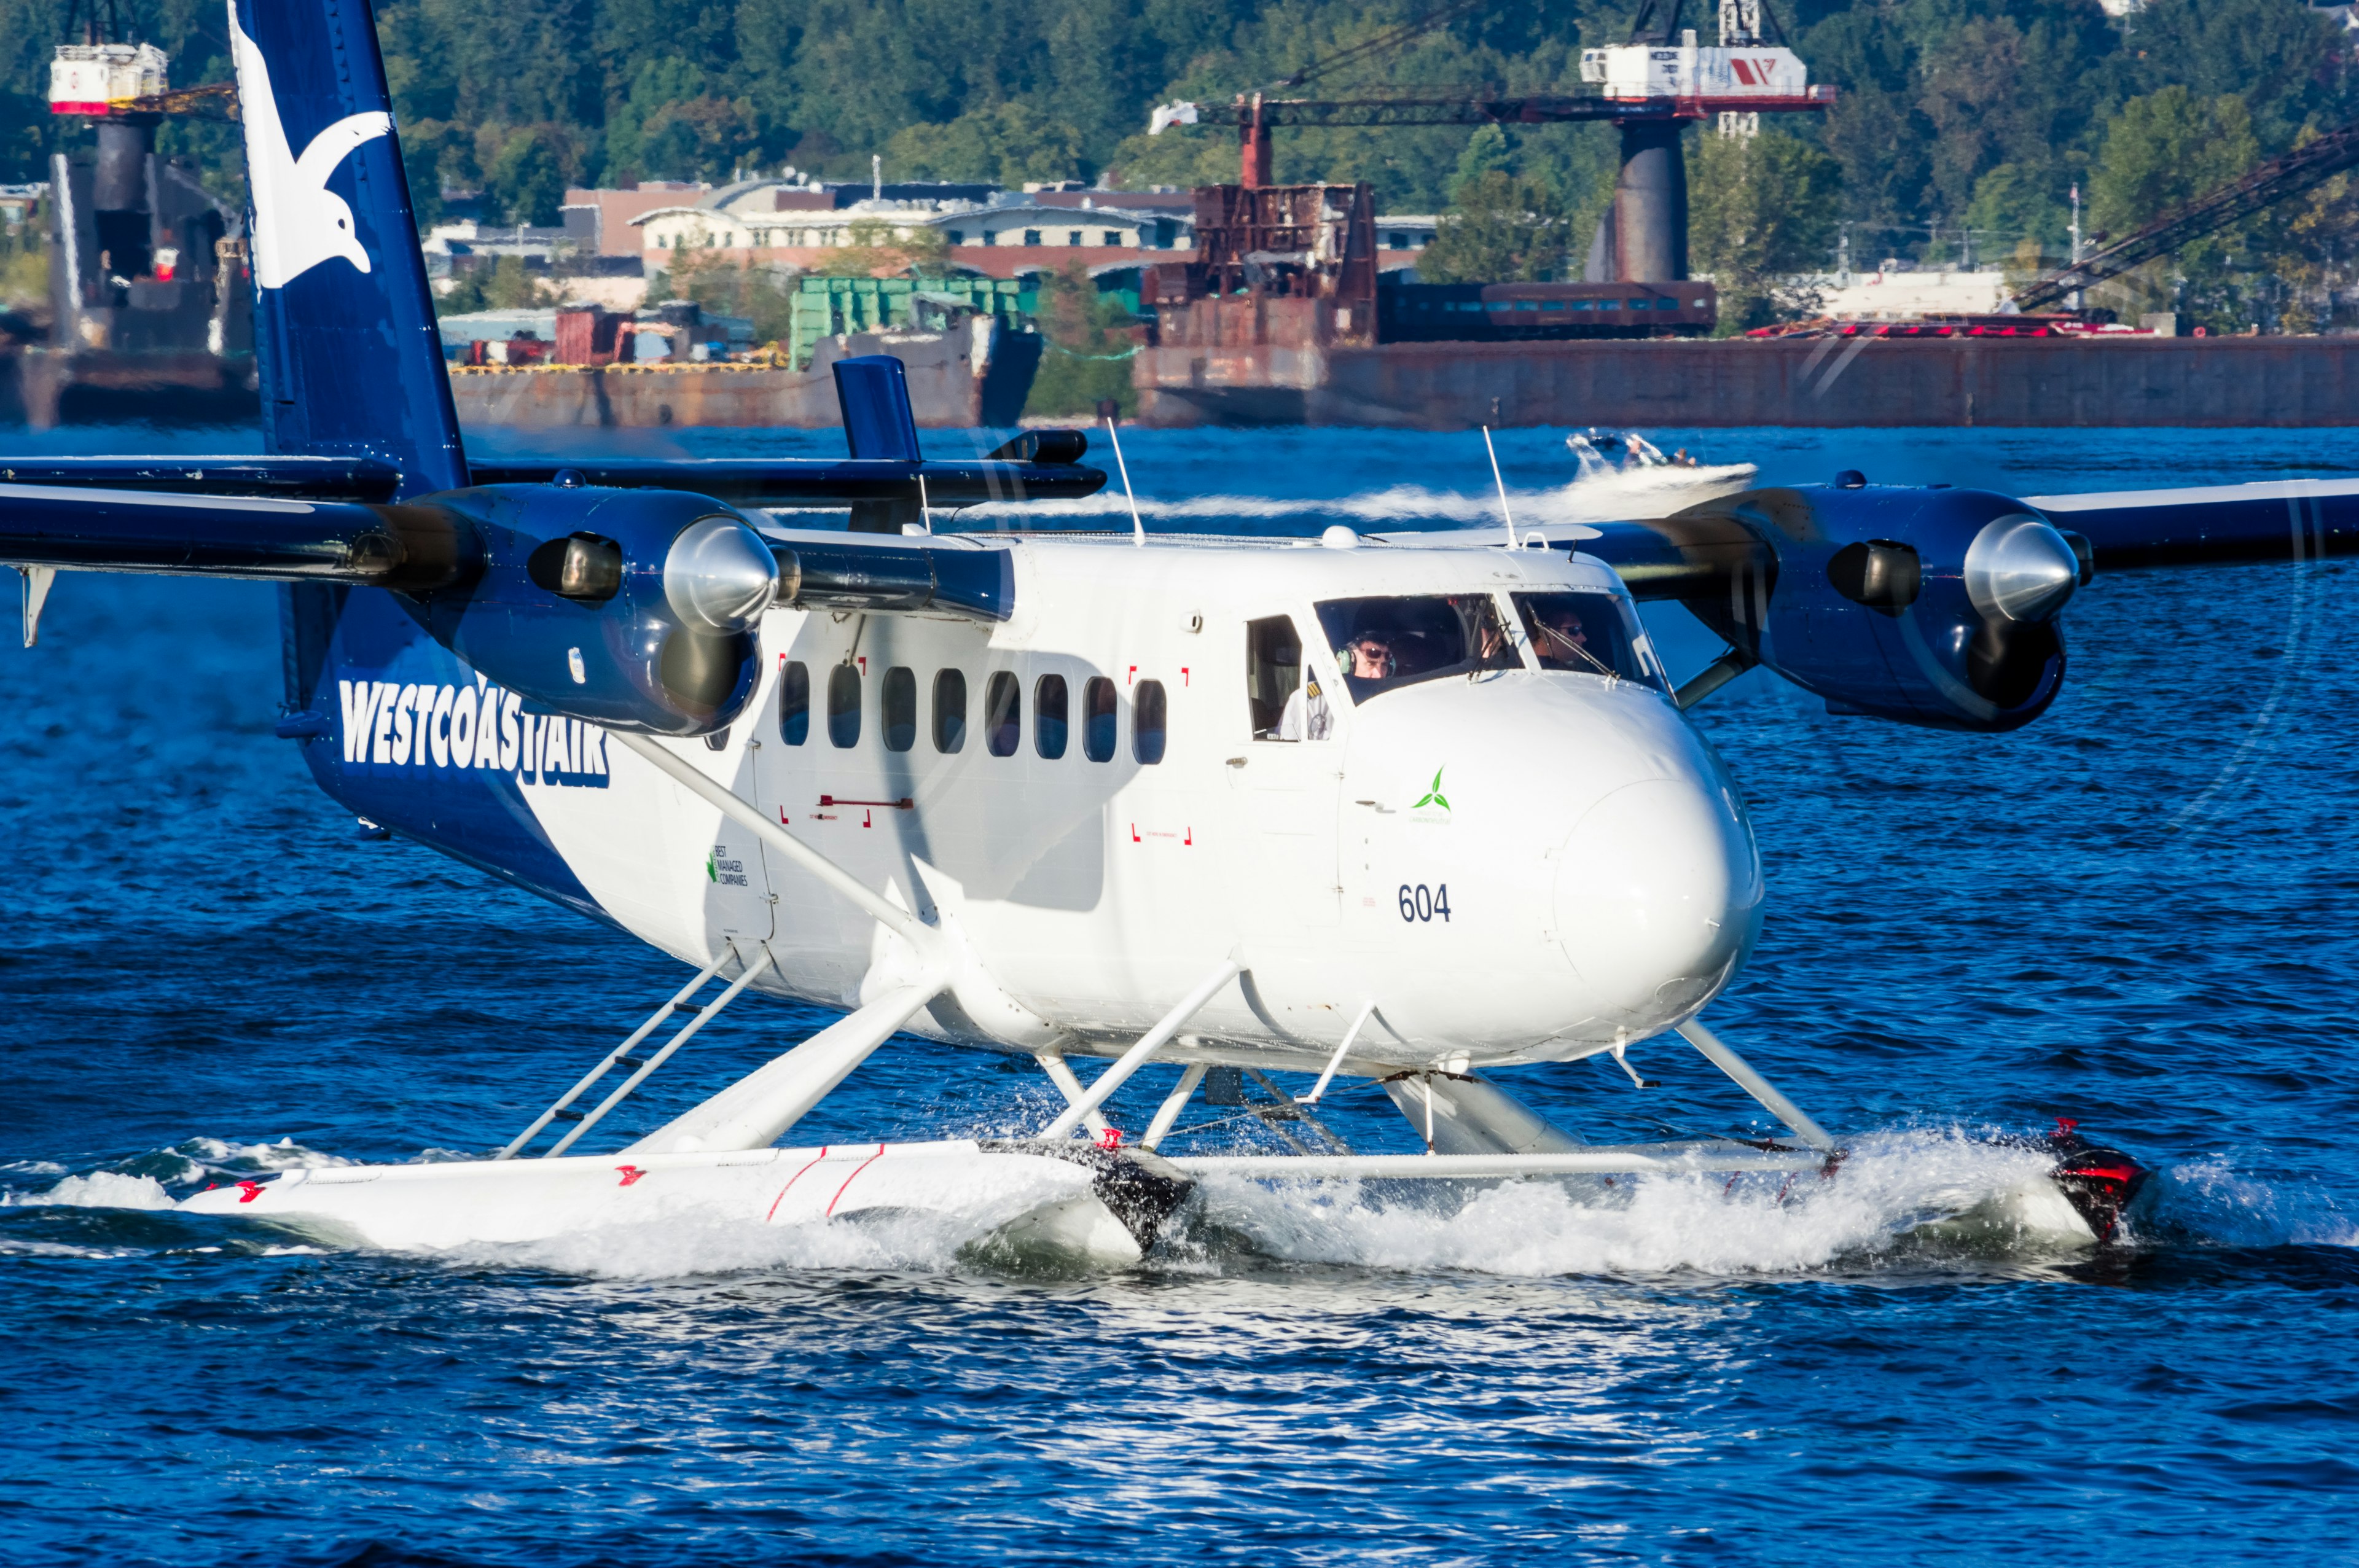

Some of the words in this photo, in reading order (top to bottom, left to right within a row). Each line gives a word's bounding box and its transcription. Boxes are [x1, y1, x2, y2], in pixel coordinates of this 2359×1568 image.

[714, 845, 727, 857] BEST
[717, 860, 743, 872] MANAGED
[719, 873, 748, 886] COMPANIES
[1399, 883, 1451, 922] 604
